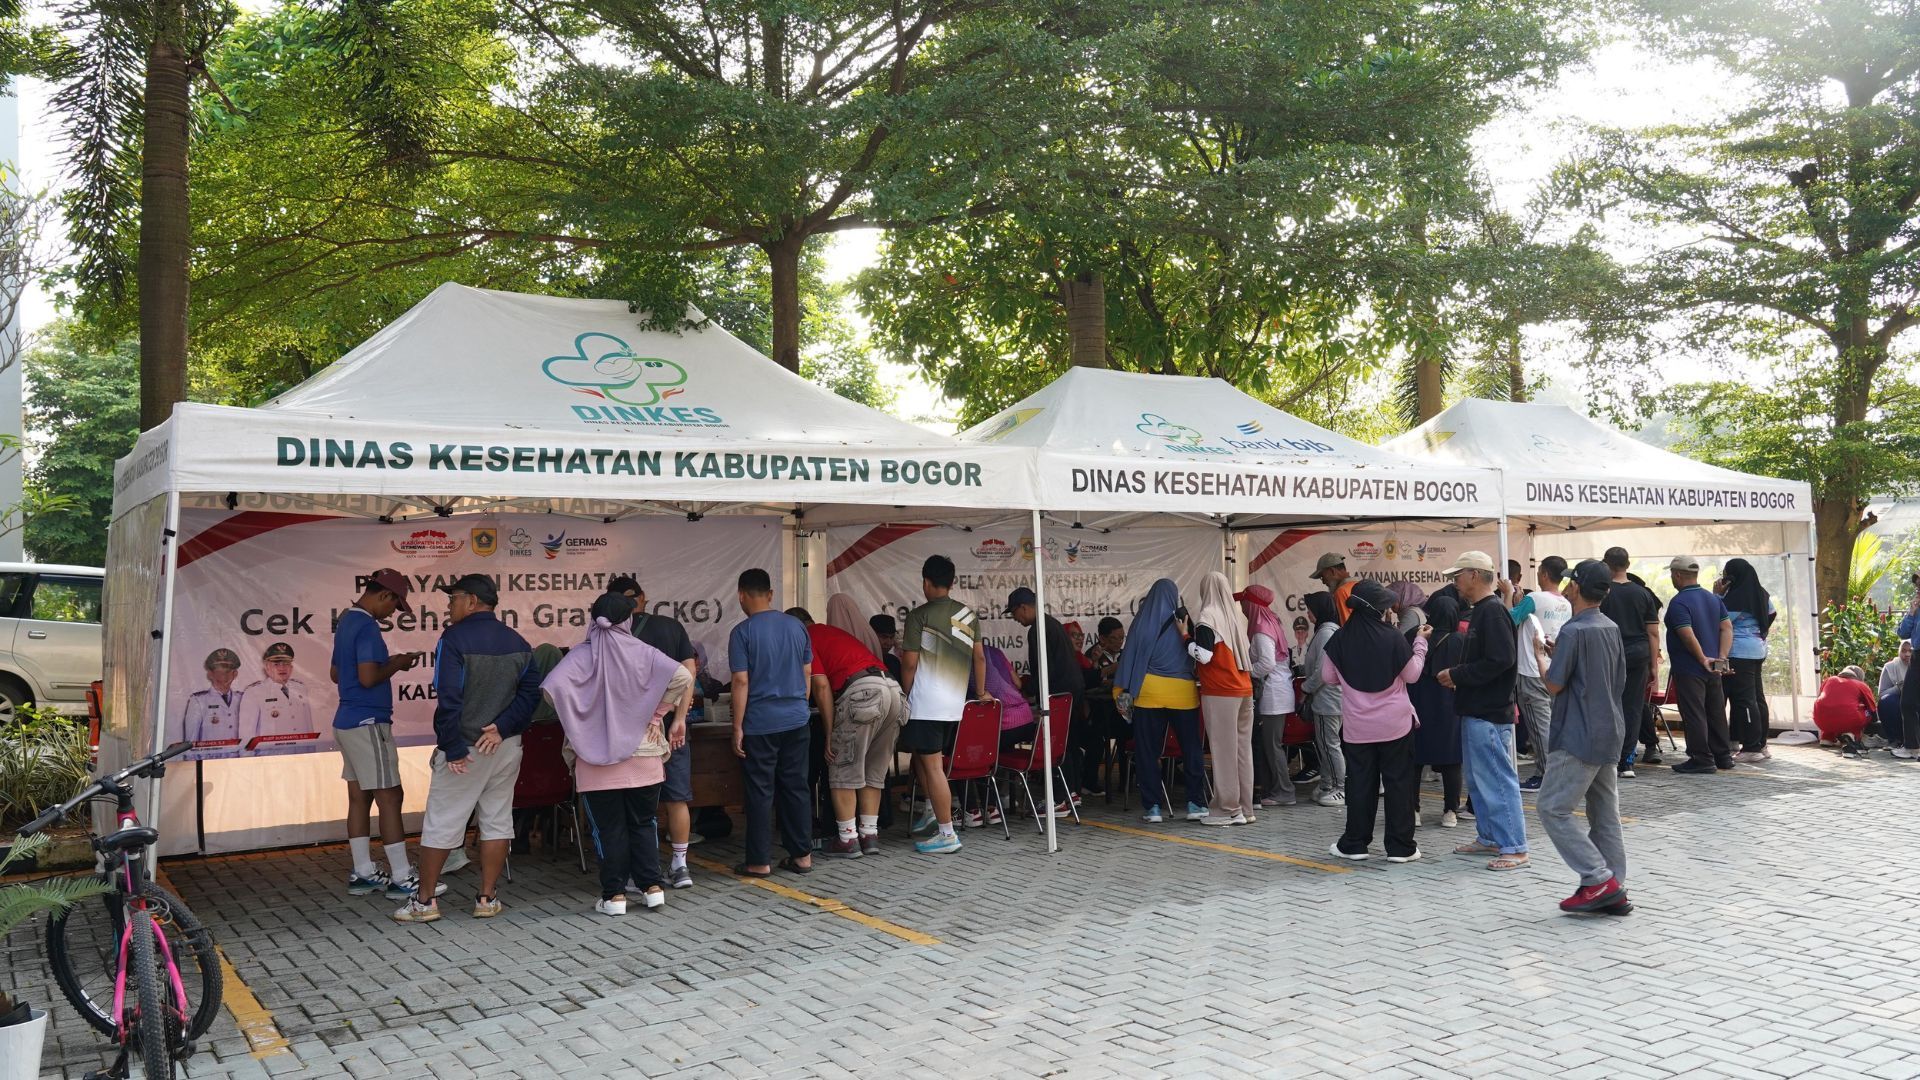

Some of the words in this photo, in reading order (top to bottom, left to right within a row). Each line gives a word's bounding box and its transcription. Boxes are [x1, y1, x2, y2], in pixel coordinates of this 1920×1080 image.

[571, 405, 722, 424] DINKES
[1220, 436, 1285, 451] bank
[1282, 438, 1335, 453] bjb
[277, 436, 414, 470] DINAS
[428, 443, 662, 476] KESEHATAN
[674, 451, 870, 482] KABUPATEN
[880, 459, 983, 487] BOGOR
[1071, 468, 1146, 493] DINAS
[1154, 471, 1286, 497] KESEHATAN
[1292, 476, 1408, 501] KABUPATEN
[1414, 481, 1479, 502] BOGOR
[1526, 482, 1574, 502] DINAS
[1578, 484, 1665, 505] KESEHATAN
[1668, 488, 1747, 508] KABUPATEN
[1751, 492, 1796, 509] BOGOR
[565, 538, 608, 547] GERMAS
[509, 549, 532, 557] DINKES
[1401, 570, 1456, 583] KESEHATA
[1285, 594, 1307, 611] Ce
[240, 607, 314, 635] Cek
[981, 635, 1024, 649] DINAS
